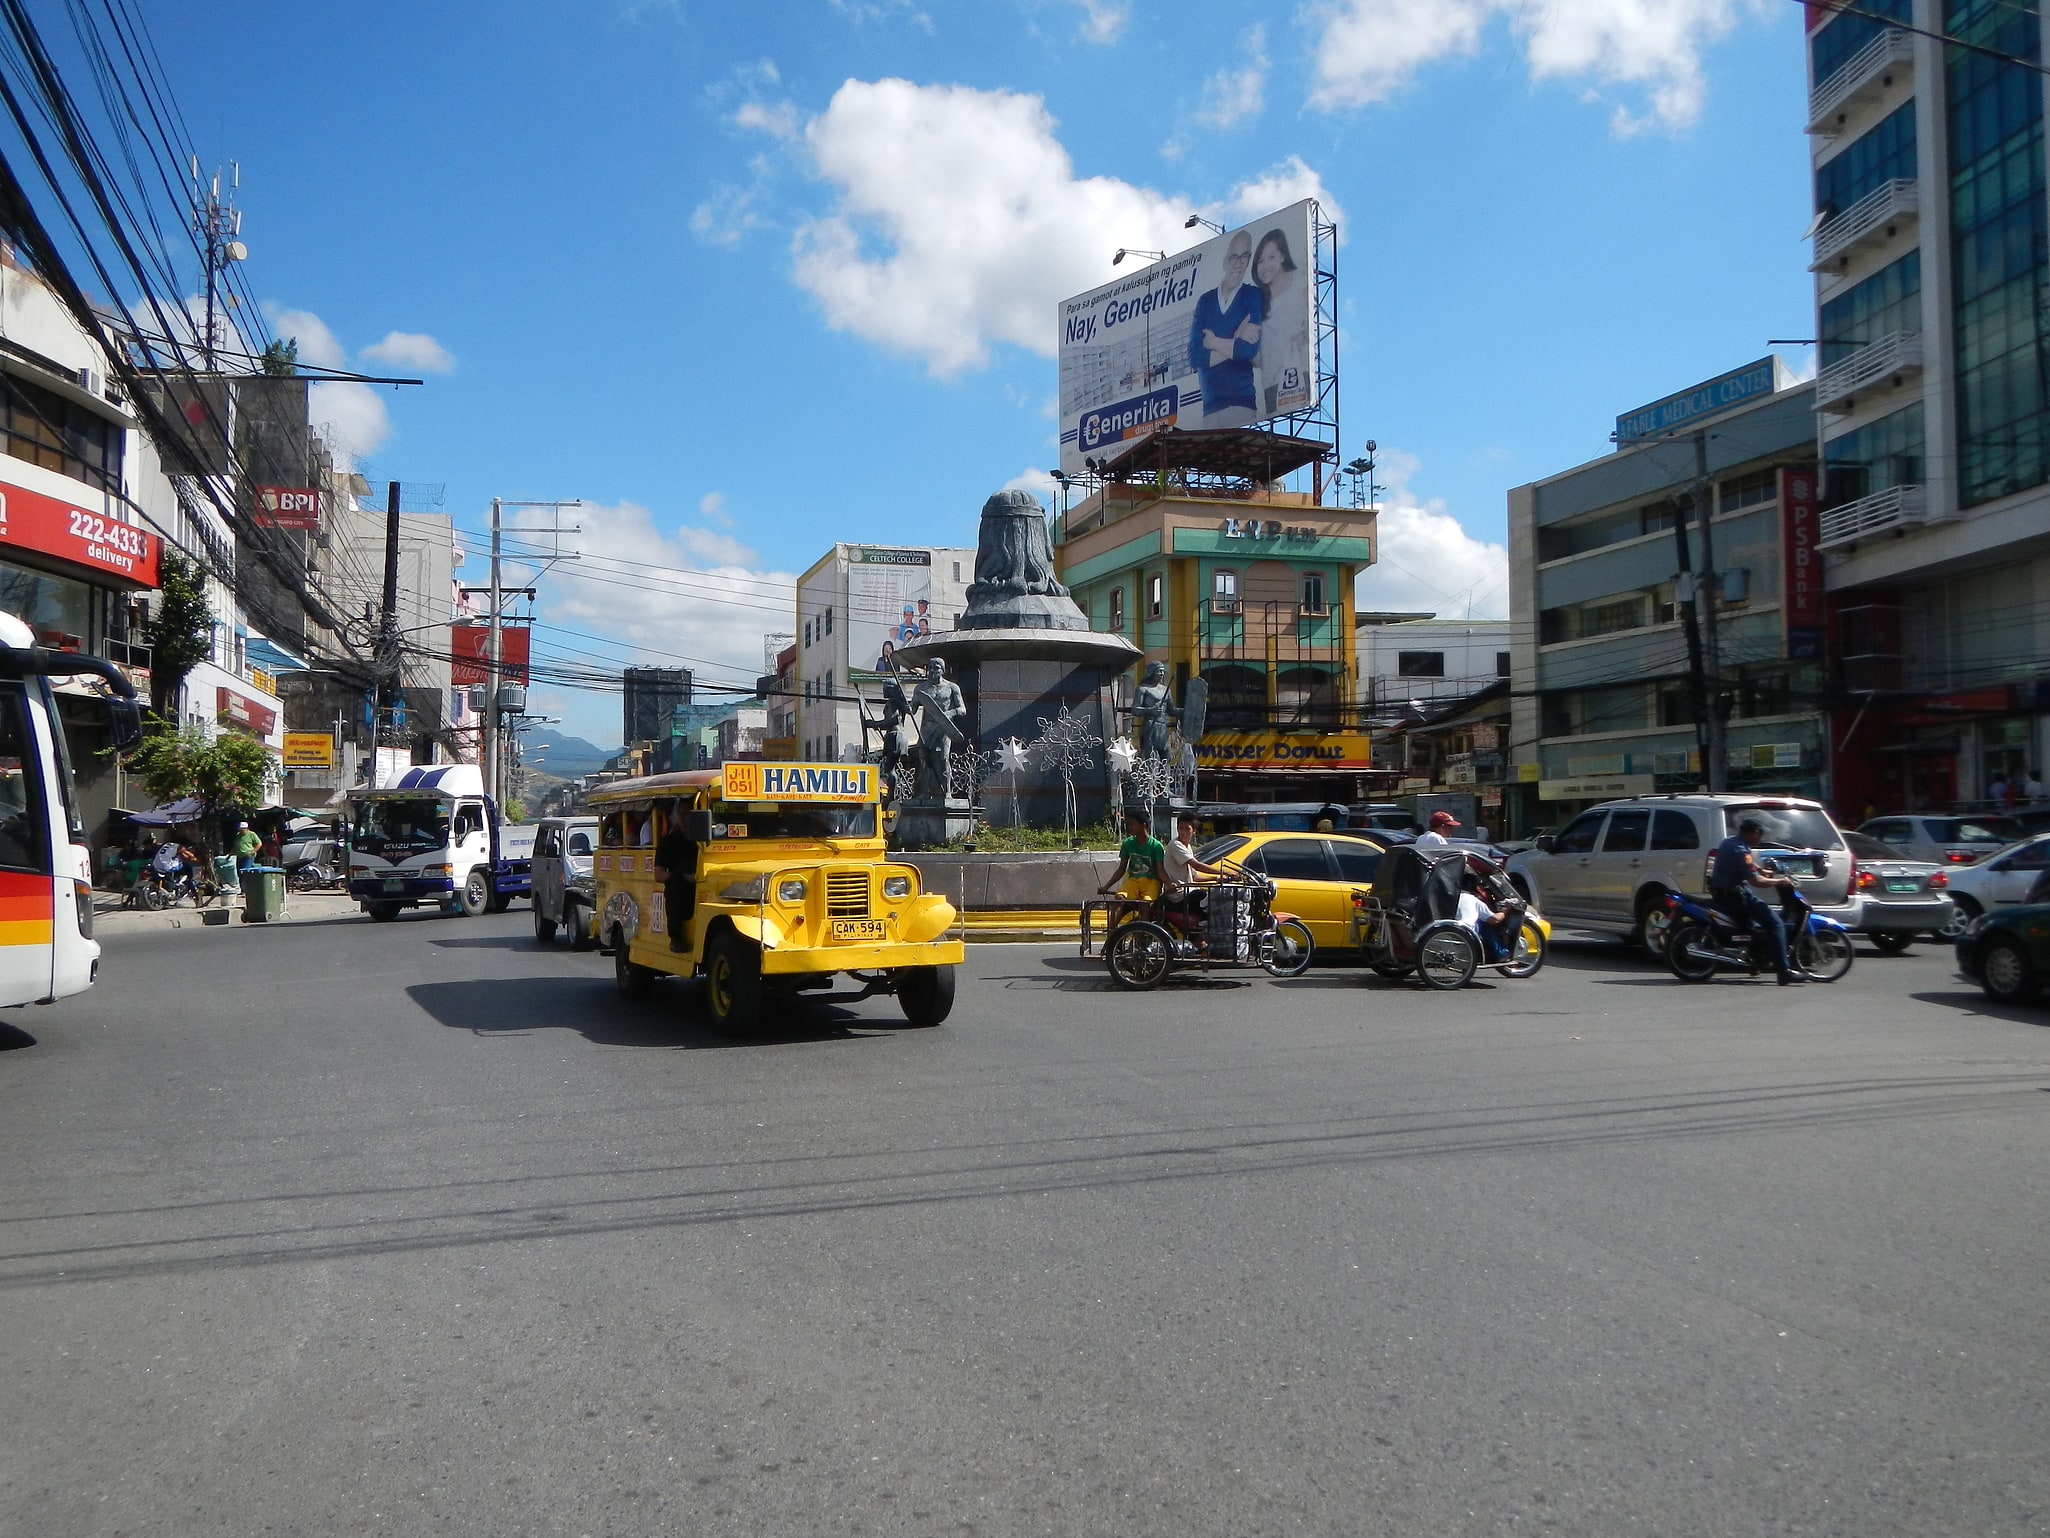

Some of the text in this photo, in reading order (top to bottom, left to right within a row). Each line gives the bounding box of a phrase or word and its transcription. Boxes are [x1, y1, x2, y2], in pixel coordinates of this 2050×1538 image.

[1066, 304, 1081, 315] Para
[1090, 291, 1112, 308] gamot
[1113, 287, 1121, 298] at
[1121, 271, 1160, 292] kalusugan
[1160, 265, 1172, 278] ng
[1171, 253, 1203, 274] pamilya
[1065, 267, 1198, 345] Nay, Generika!
[1662, 387, 1716, 426] MEDICAL
[1719, 366, 1771, 402] CENTER
[1083, 398, 1170, 446] Generika
[280, 492, 315, 513] BPI
[69, 510, 148, 558] 222-4333
[87, 542, 134, 572] delivery
[869, 555, 924, 564] CELTECH COLLEGE
[1794, 506, 1810, 609] PSBank
[1194, 743, 1346, 760] mister Donut
[729, 780, 753, 793] 051
[763, 768, 868, 794] HAMILI
